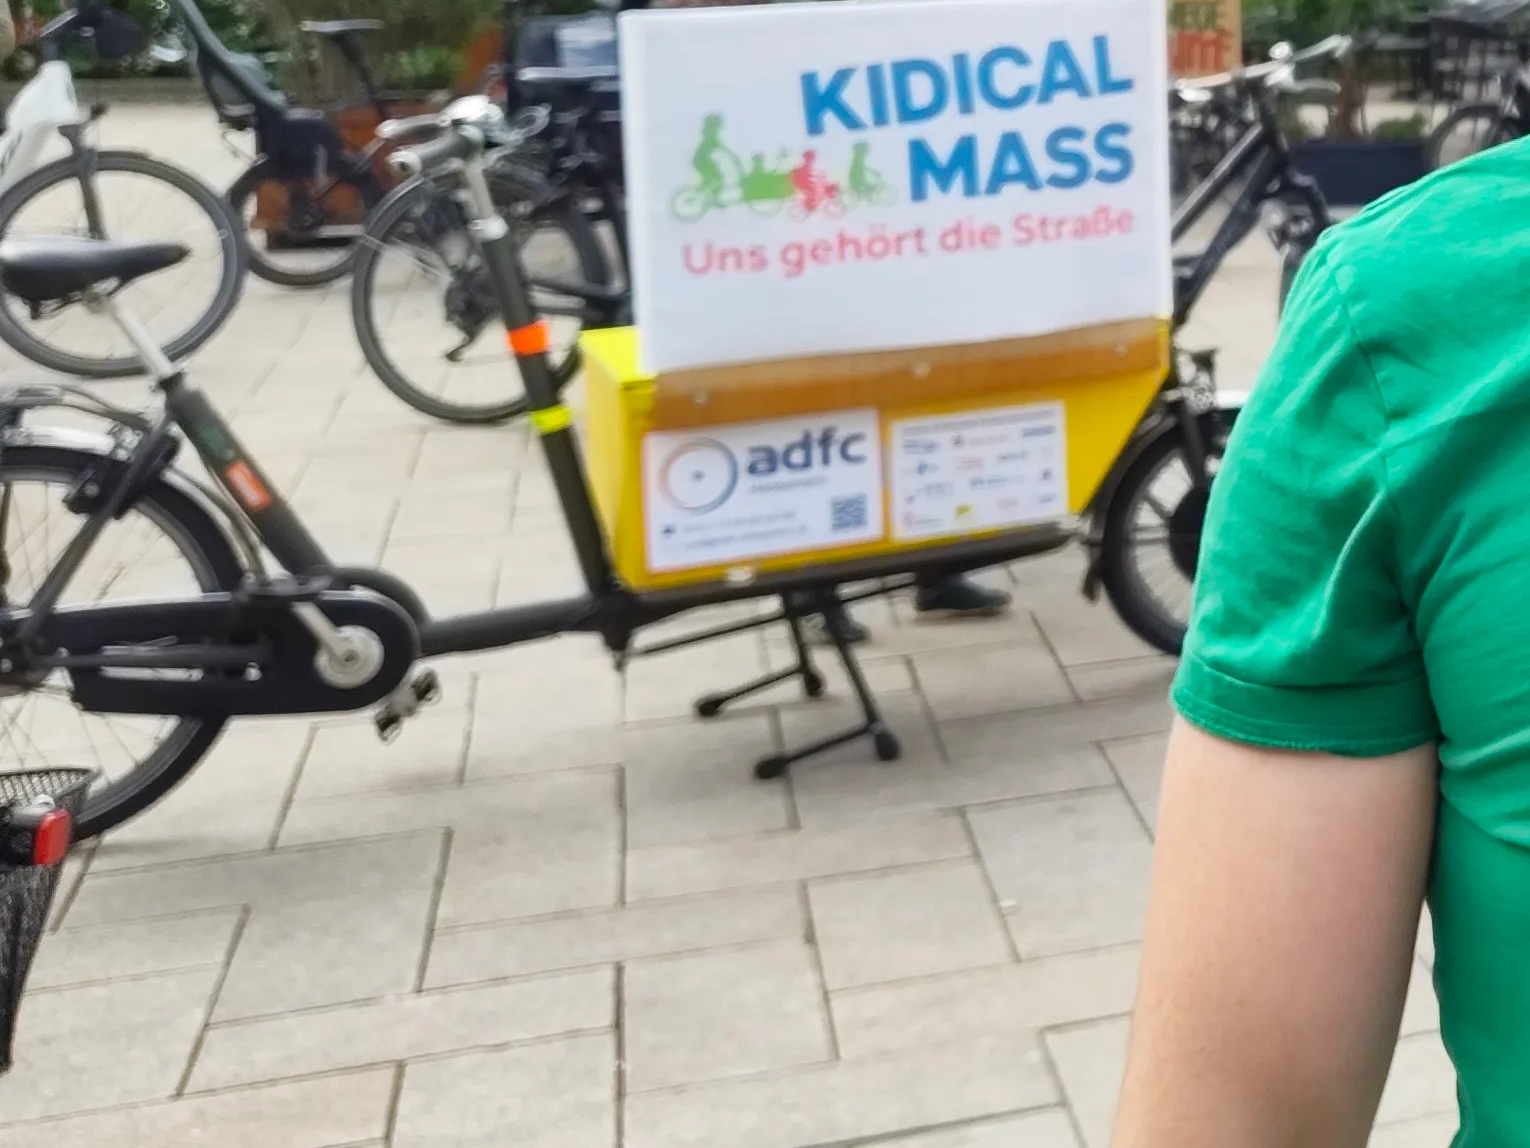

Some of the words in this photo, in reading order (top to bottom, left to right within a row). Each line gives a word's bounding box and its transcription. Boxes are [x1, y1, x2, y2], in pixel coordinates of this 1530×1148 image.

[800, 34, 1134, 136] KIDICAL
[908, 122, 1134, 202] MASS
[683, 242, 768, 275] Uns
[780, 223, 928, 278] gehört
[939, 219, 1002, 253] die
[1012, 204, 1134, 247] Straße
[747, 427, 868, 476] adfc
